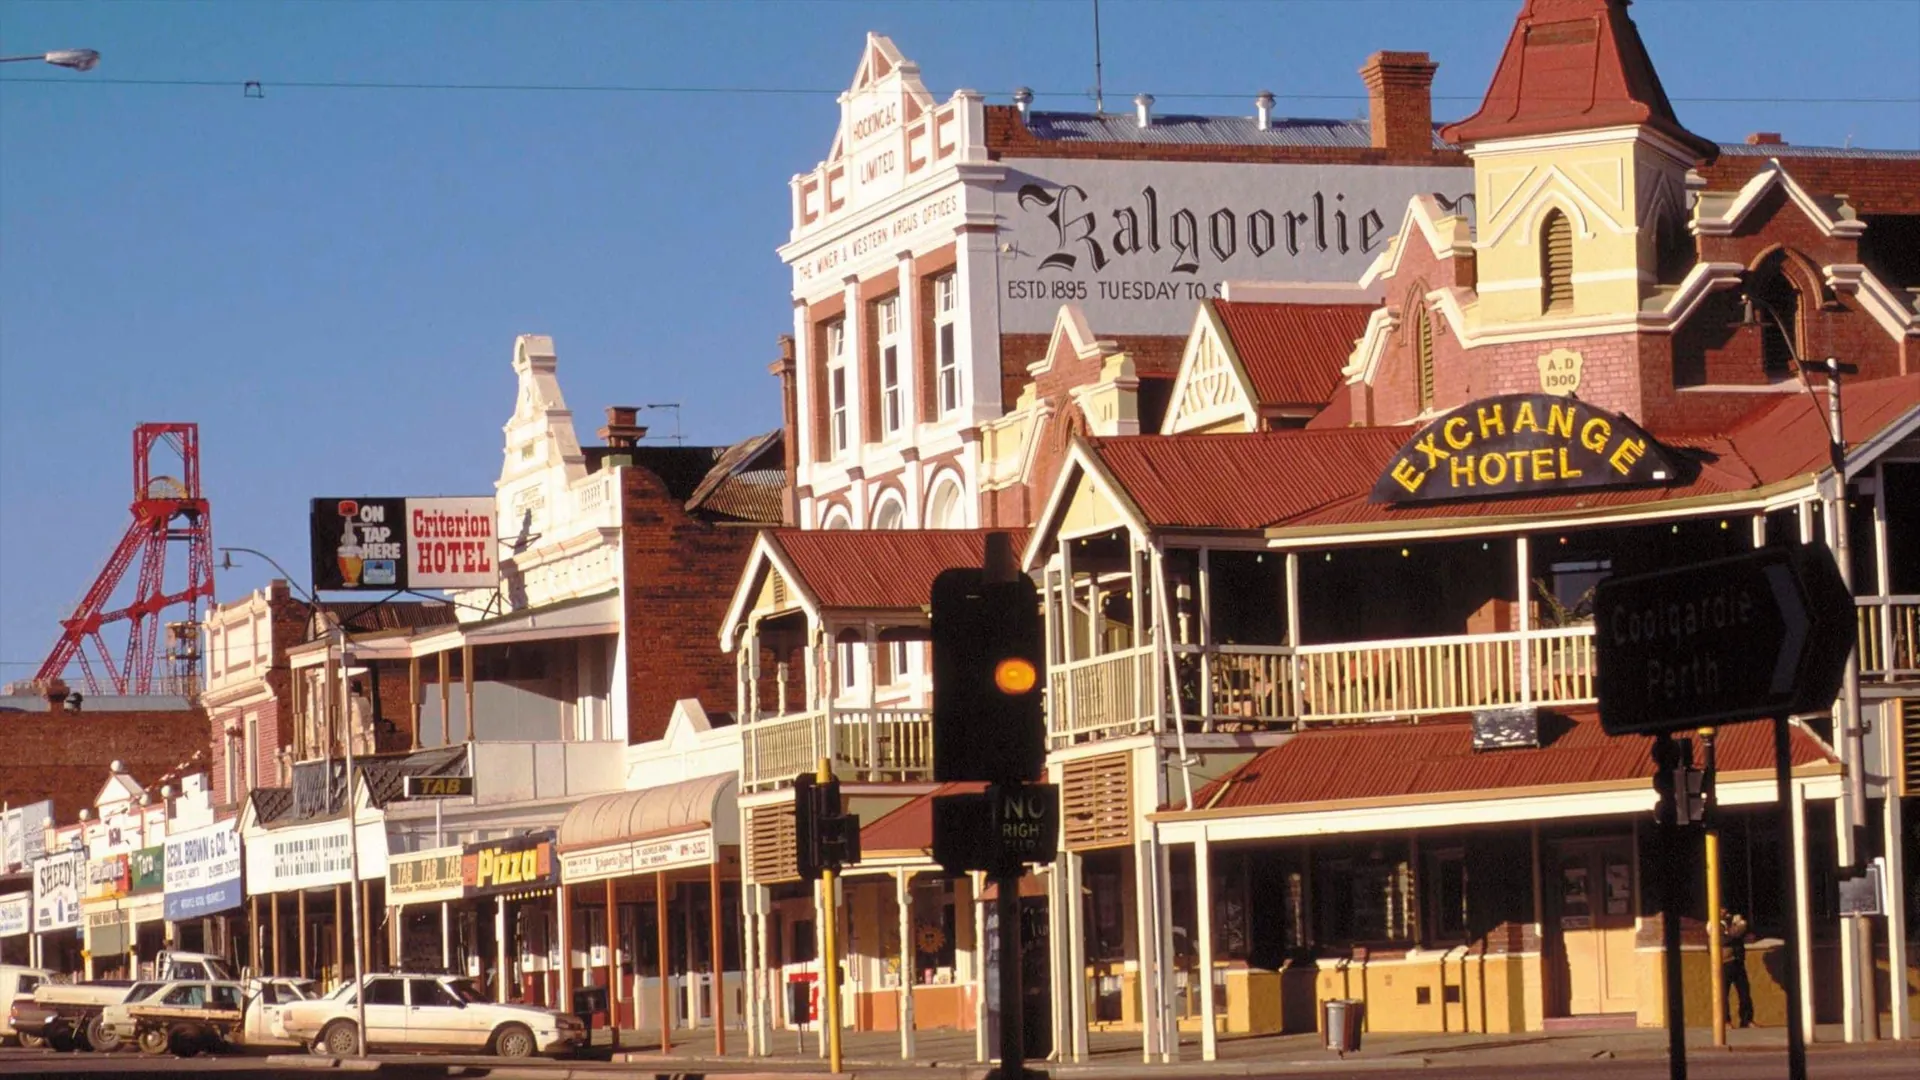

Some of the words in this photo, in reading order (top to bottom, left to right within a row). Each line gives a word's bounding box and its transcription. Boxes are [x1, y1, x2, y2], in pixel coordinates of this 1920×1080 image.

[861, 150, 894, 184] LIMITED
[799, 262, 812, 281] THE
[817, 250, 838, 274] MINER
[853, 227, 888, 256] WESTERN
[922, 195, 957, 225] OFFICES
[1017, 184, 1385, 275] Kalgoorlie
[1098, 281, 1180, 300] TUESDAY
[1186, 282, 1207, 300] TO
[1546, 374, 1576, 387] 1900
[1391, 402, 1647, 493] EXCHANGE
[1451, 447, 1582, 487] HOTEL
[361, 505, 384, 522] ON
[413, 509, 491, 538] Criterion
[361, 527, 391, 543] TAP
[363, 543, 401, 559] HERE
[417, 542, 491, 573] HOTEL
[1611, 587, 1752, 649] Coolgardie
[420, 778, 461, 794] TAB
[1004, 795, 1045, 819] NO
[1002, 823, 1045, 838] RIGH
[185, 836, 209, 864] BROWN
[397, 862, 413, 886] TAB
[421, 859, 438, 883] TAB
[445, 856, 462, 880] TAB
[476, 848, 537, 888] Pizza
